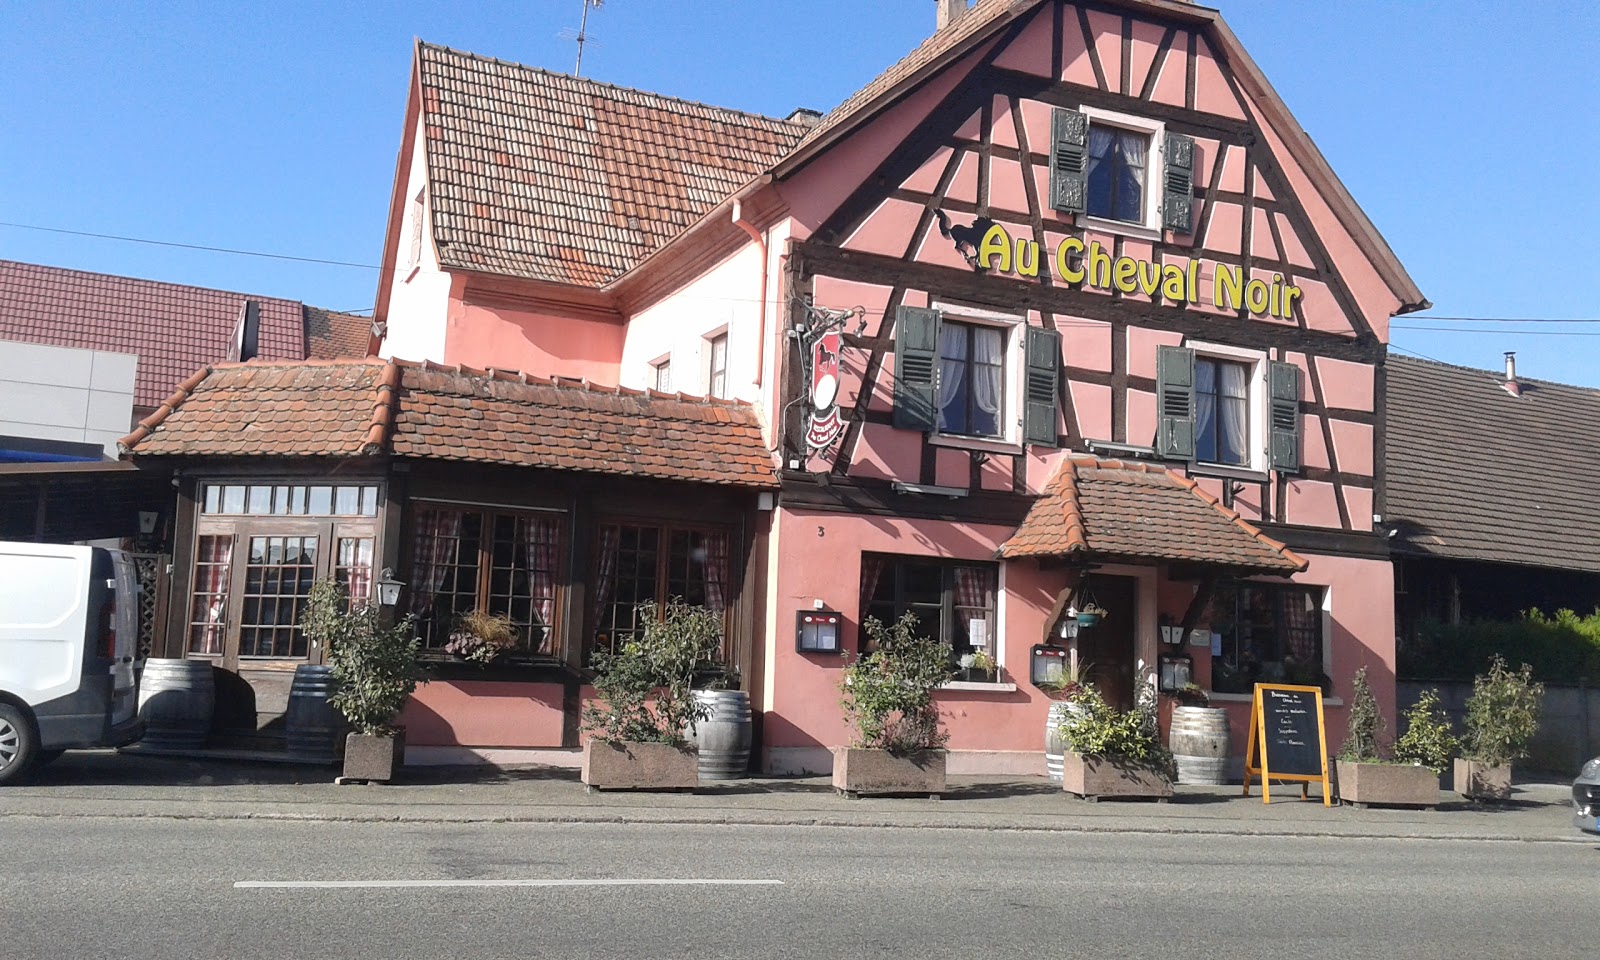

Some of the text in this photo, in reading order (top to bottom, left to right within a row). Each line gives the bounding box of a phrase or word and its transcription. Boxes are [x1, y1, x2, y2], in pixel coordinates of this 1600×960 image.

[979, 224, 1301, 319] Au Cheval Noir
[817, 526, 825, 537] 3
